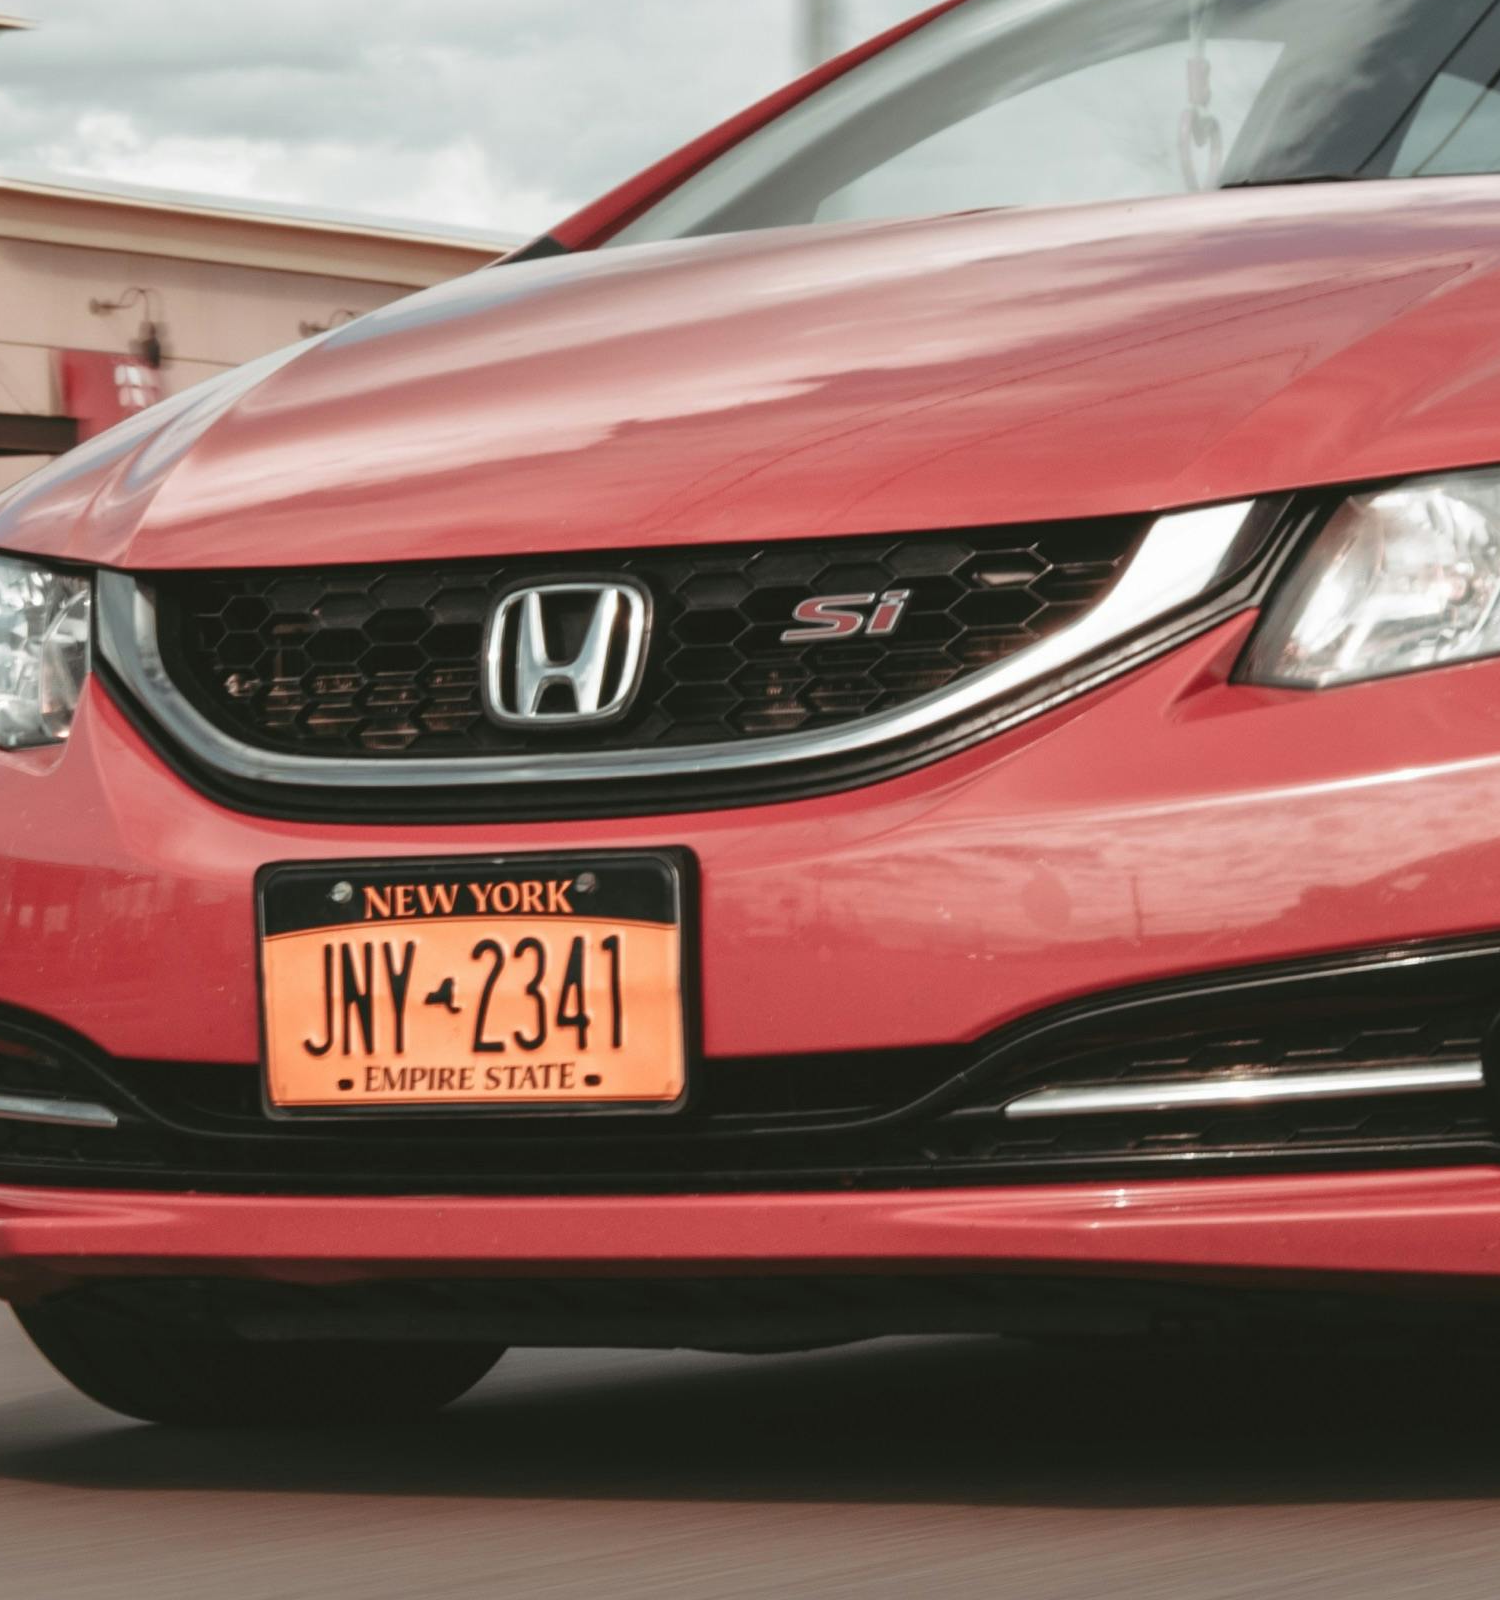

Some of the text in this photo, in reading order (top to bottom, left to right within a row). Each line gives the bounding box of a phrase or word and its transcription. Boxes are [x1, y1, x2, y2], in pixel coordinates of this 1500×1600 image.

[363, 878, 574, 919] NEW YORK
[303, 934, 621, 1056] JNY 2341
[364, 1062, 576, 1093] EMPIRE STATE
